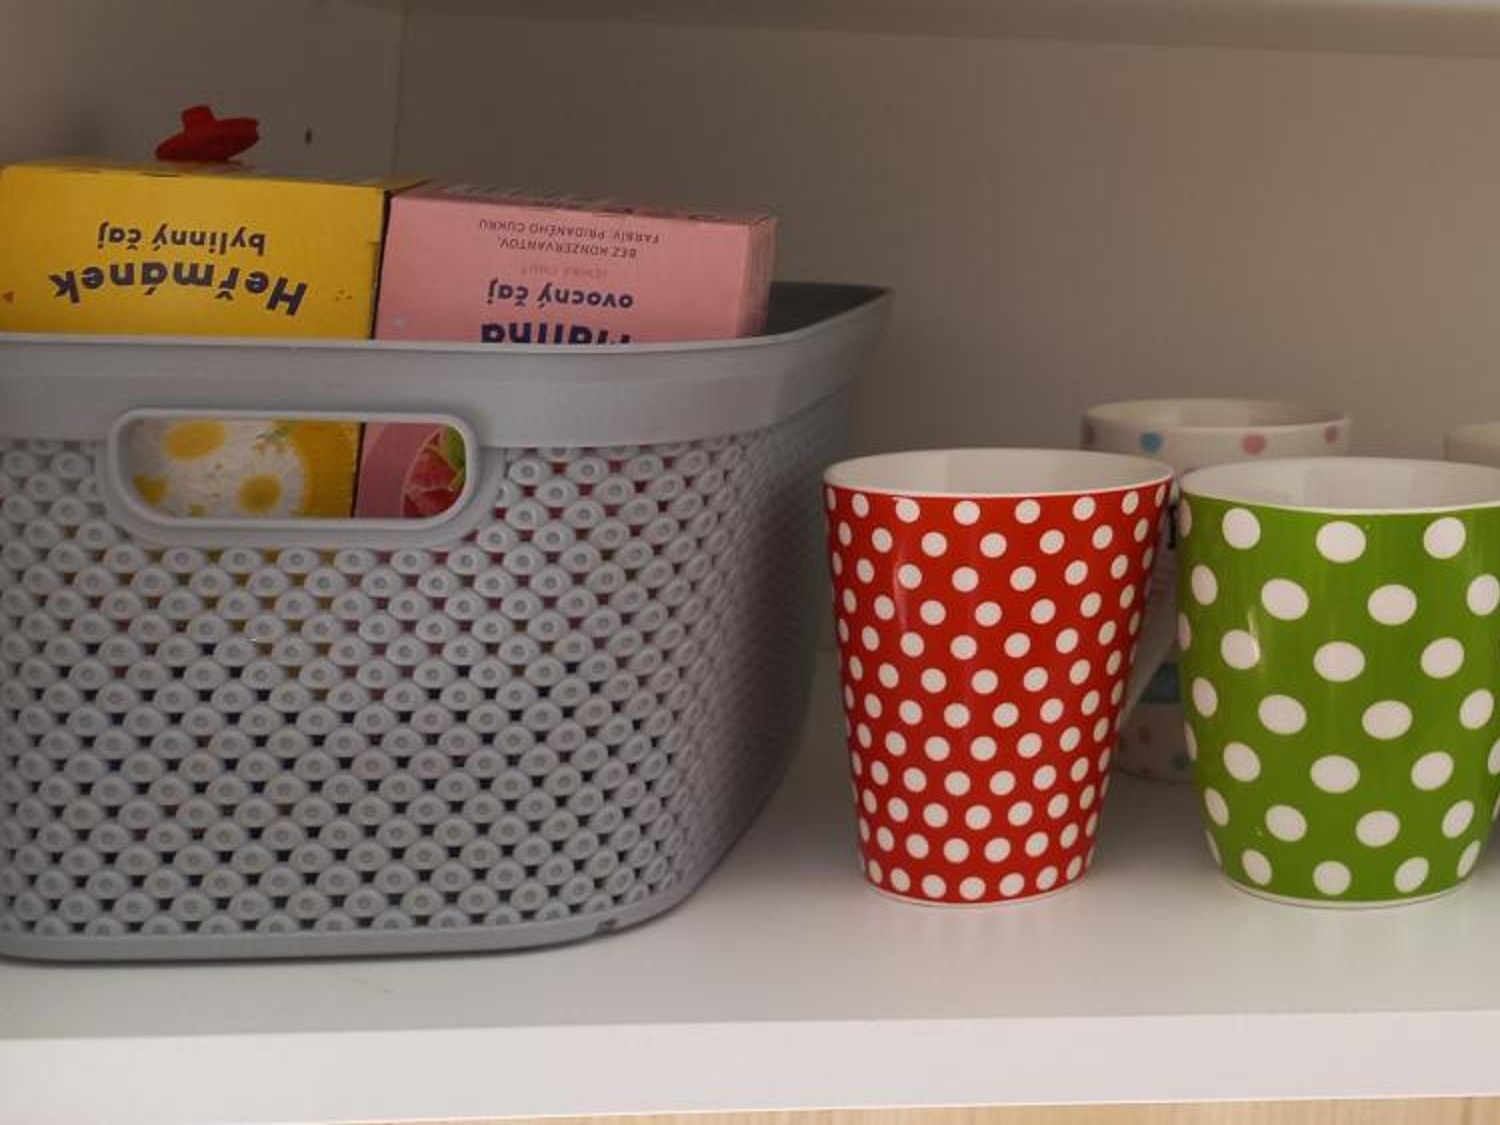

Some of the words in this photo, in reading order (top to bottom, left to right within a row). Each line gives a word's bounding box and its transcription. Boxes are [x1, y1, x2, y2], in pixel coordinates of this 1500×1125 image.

[97, 221, 142, 250] čaj
[153, 223, 265, 256] bylinný
[611, 247, 637, 259] BEZ
[48, 261, 308, 316] Heřmánek
[486, 278, 529, 308] čaj
[537, 282, 634, 309] ovocný
